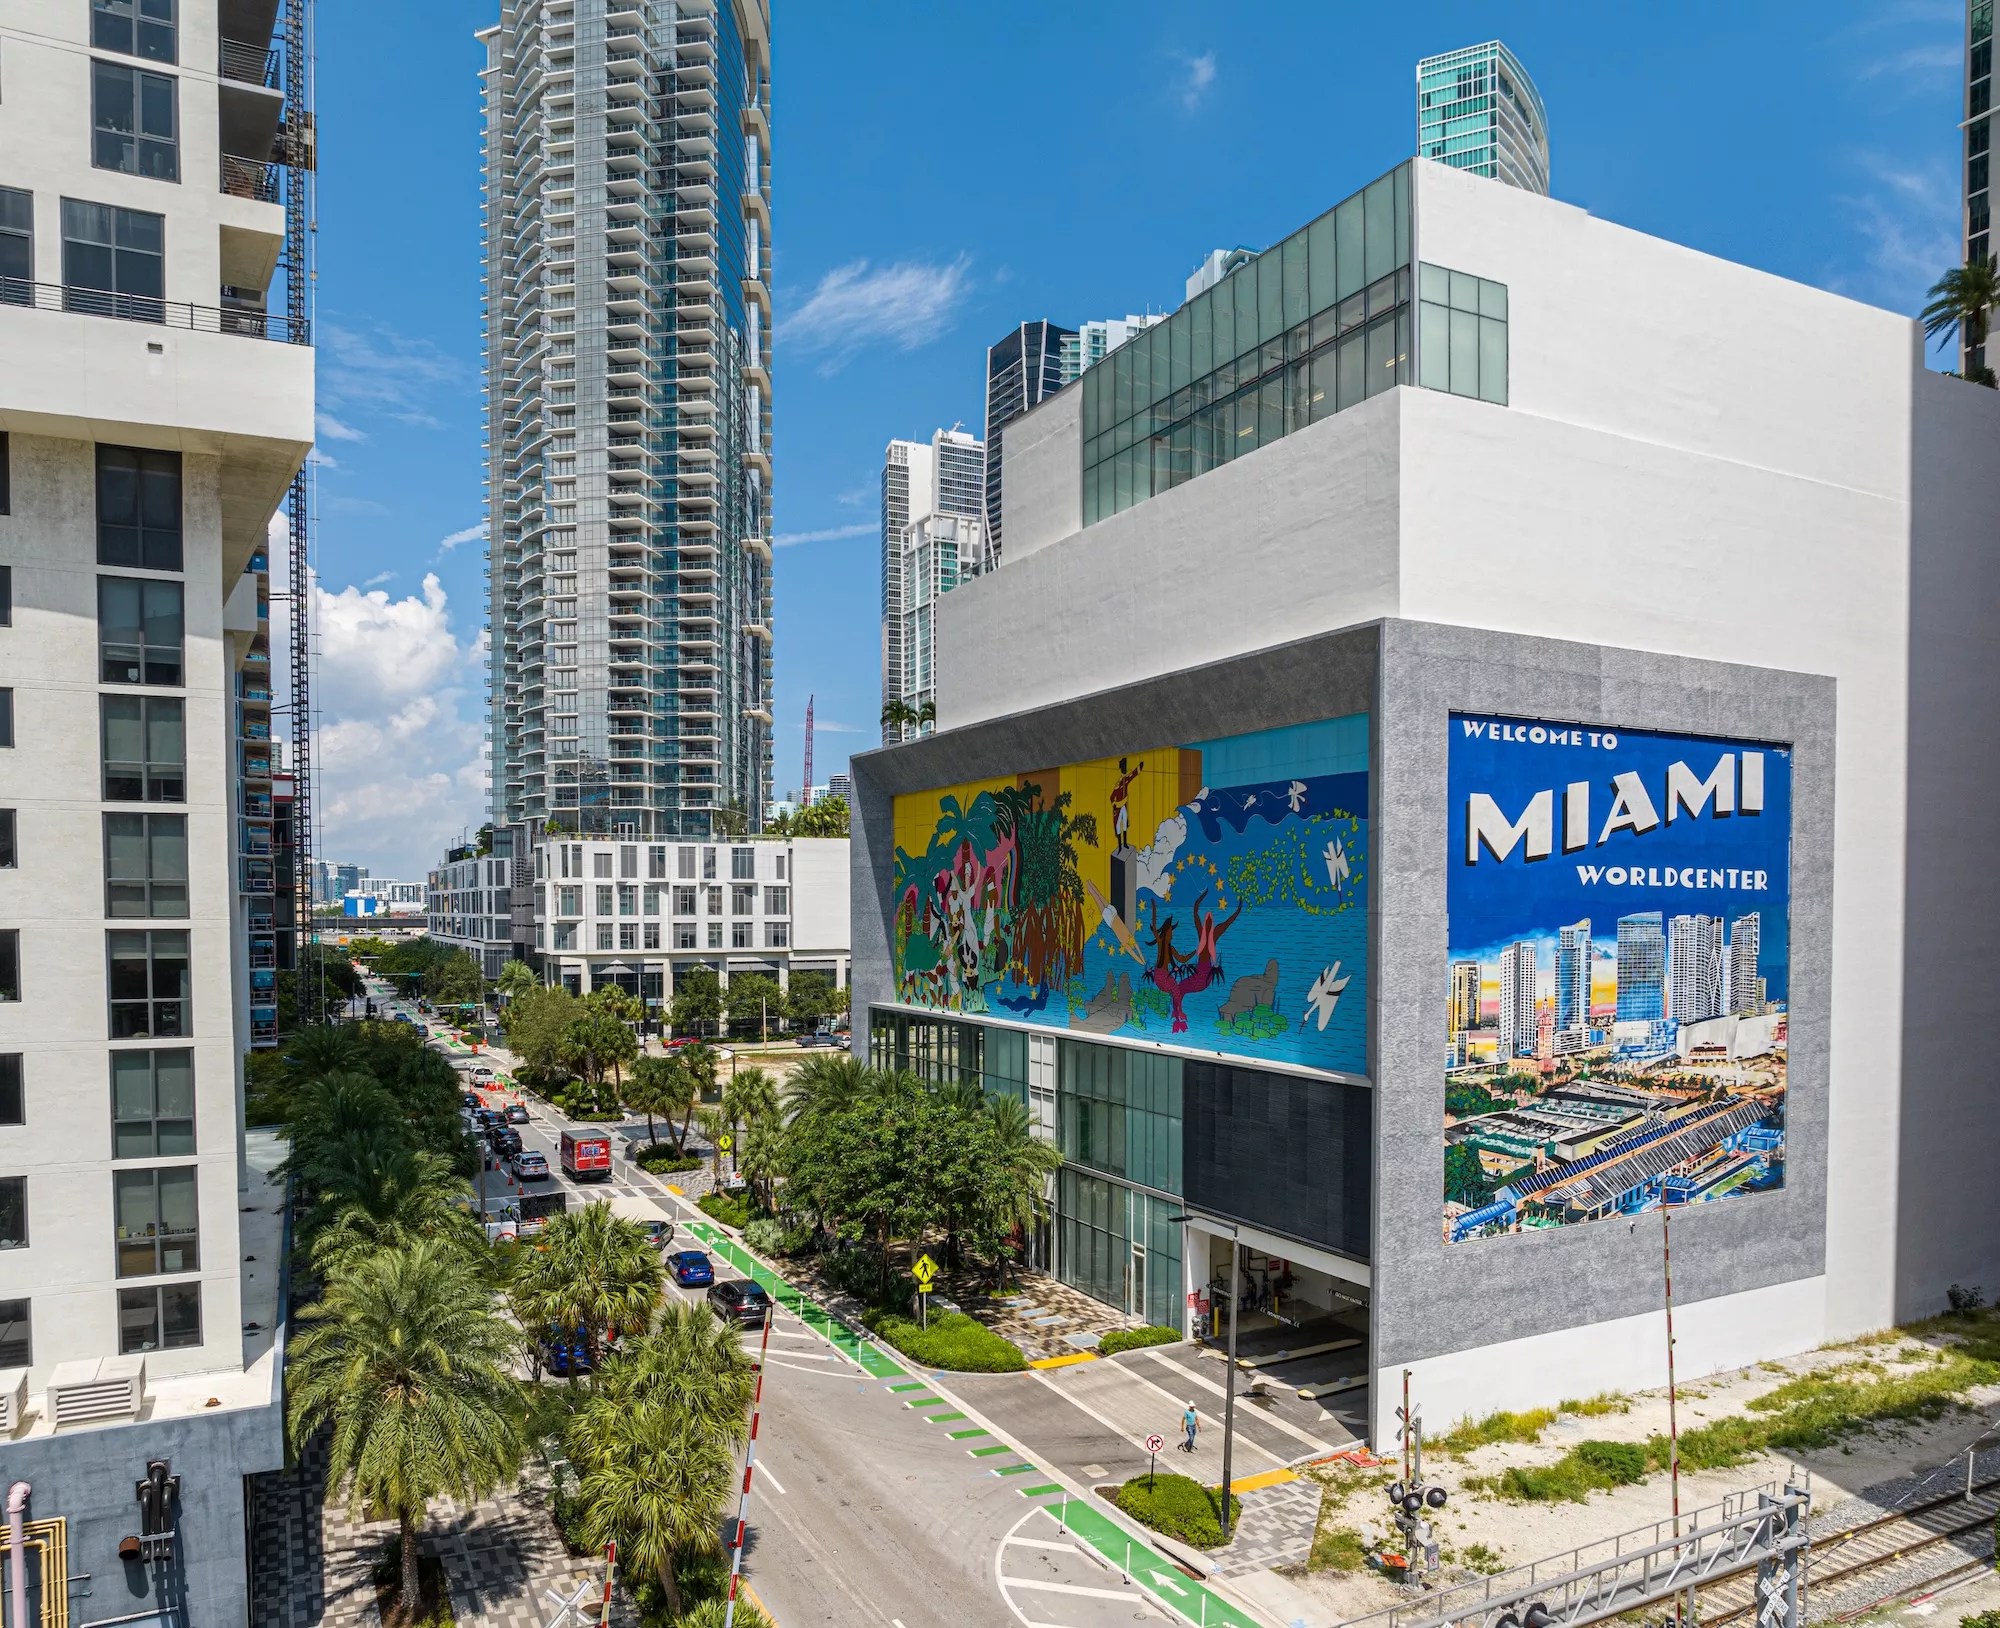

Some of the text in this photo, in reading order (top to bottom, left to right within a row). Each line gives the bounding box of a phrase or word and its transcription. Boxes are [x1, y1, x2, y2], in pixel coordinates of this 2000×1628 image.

[1462, 720, 1618, 751] WELCOME TO
[1467, 751, 1764, 864] MIAMI
[1576, 865, 1769, 891] WORLDCENTER
